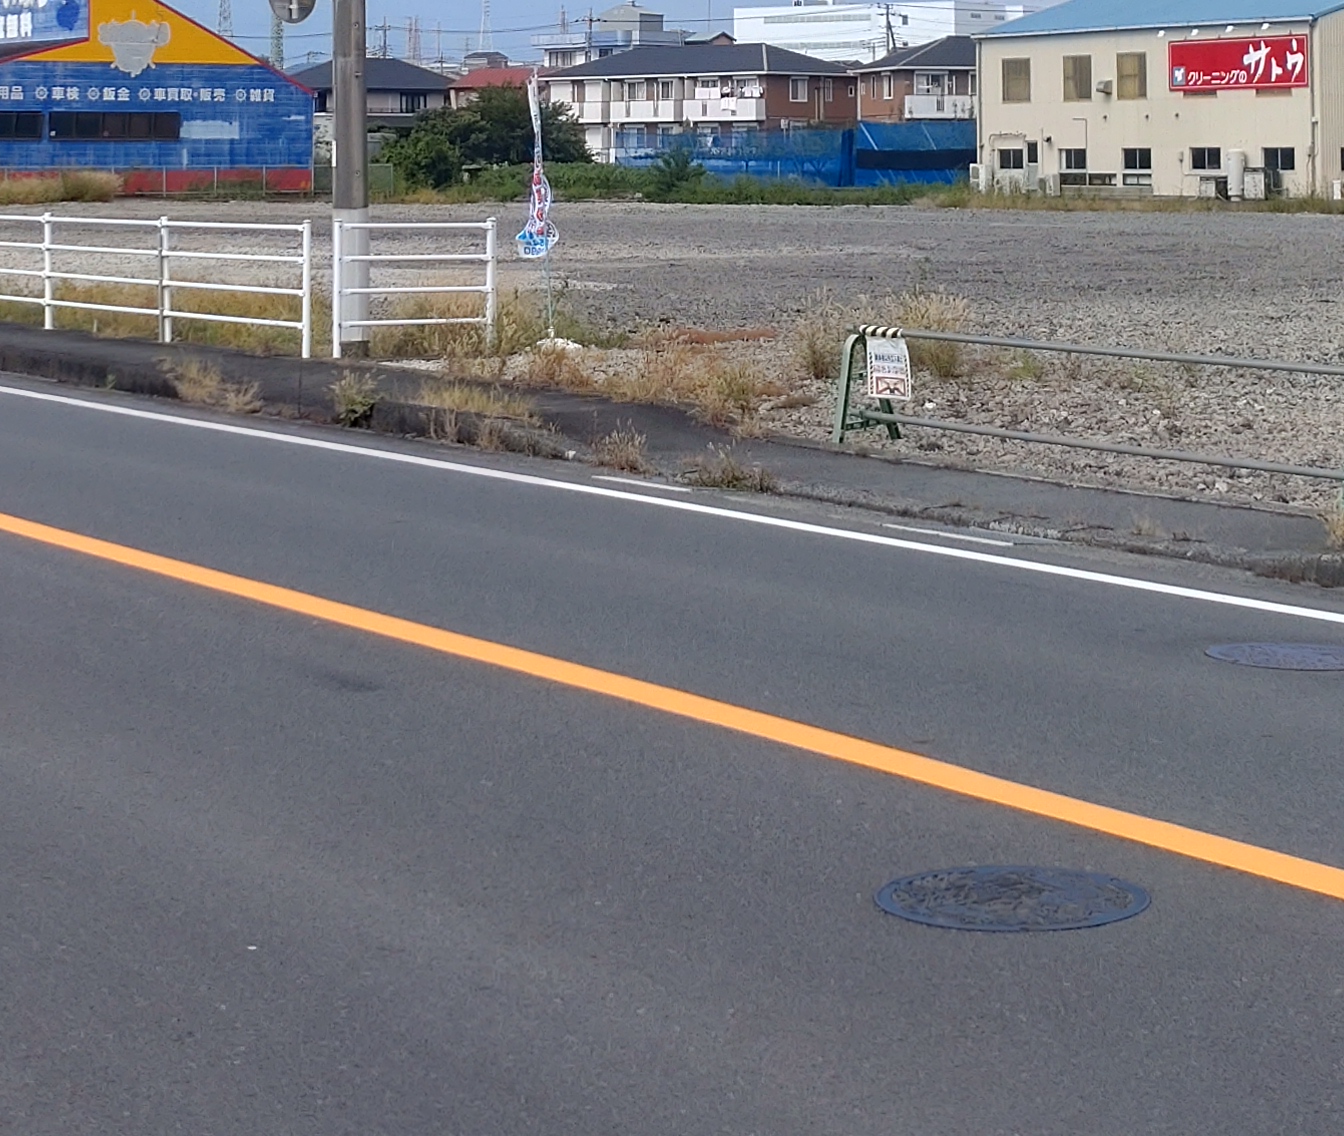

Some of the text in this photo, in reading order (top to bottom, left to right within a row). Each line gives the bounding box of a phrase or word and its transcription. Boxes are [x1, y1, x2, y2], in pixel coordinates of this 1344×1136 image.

[1188, 38, 1304, 85] クリーニングの サトウ
[51, 87, 80, 100] 車検
[250, 88, 275, 102] 雑貨
